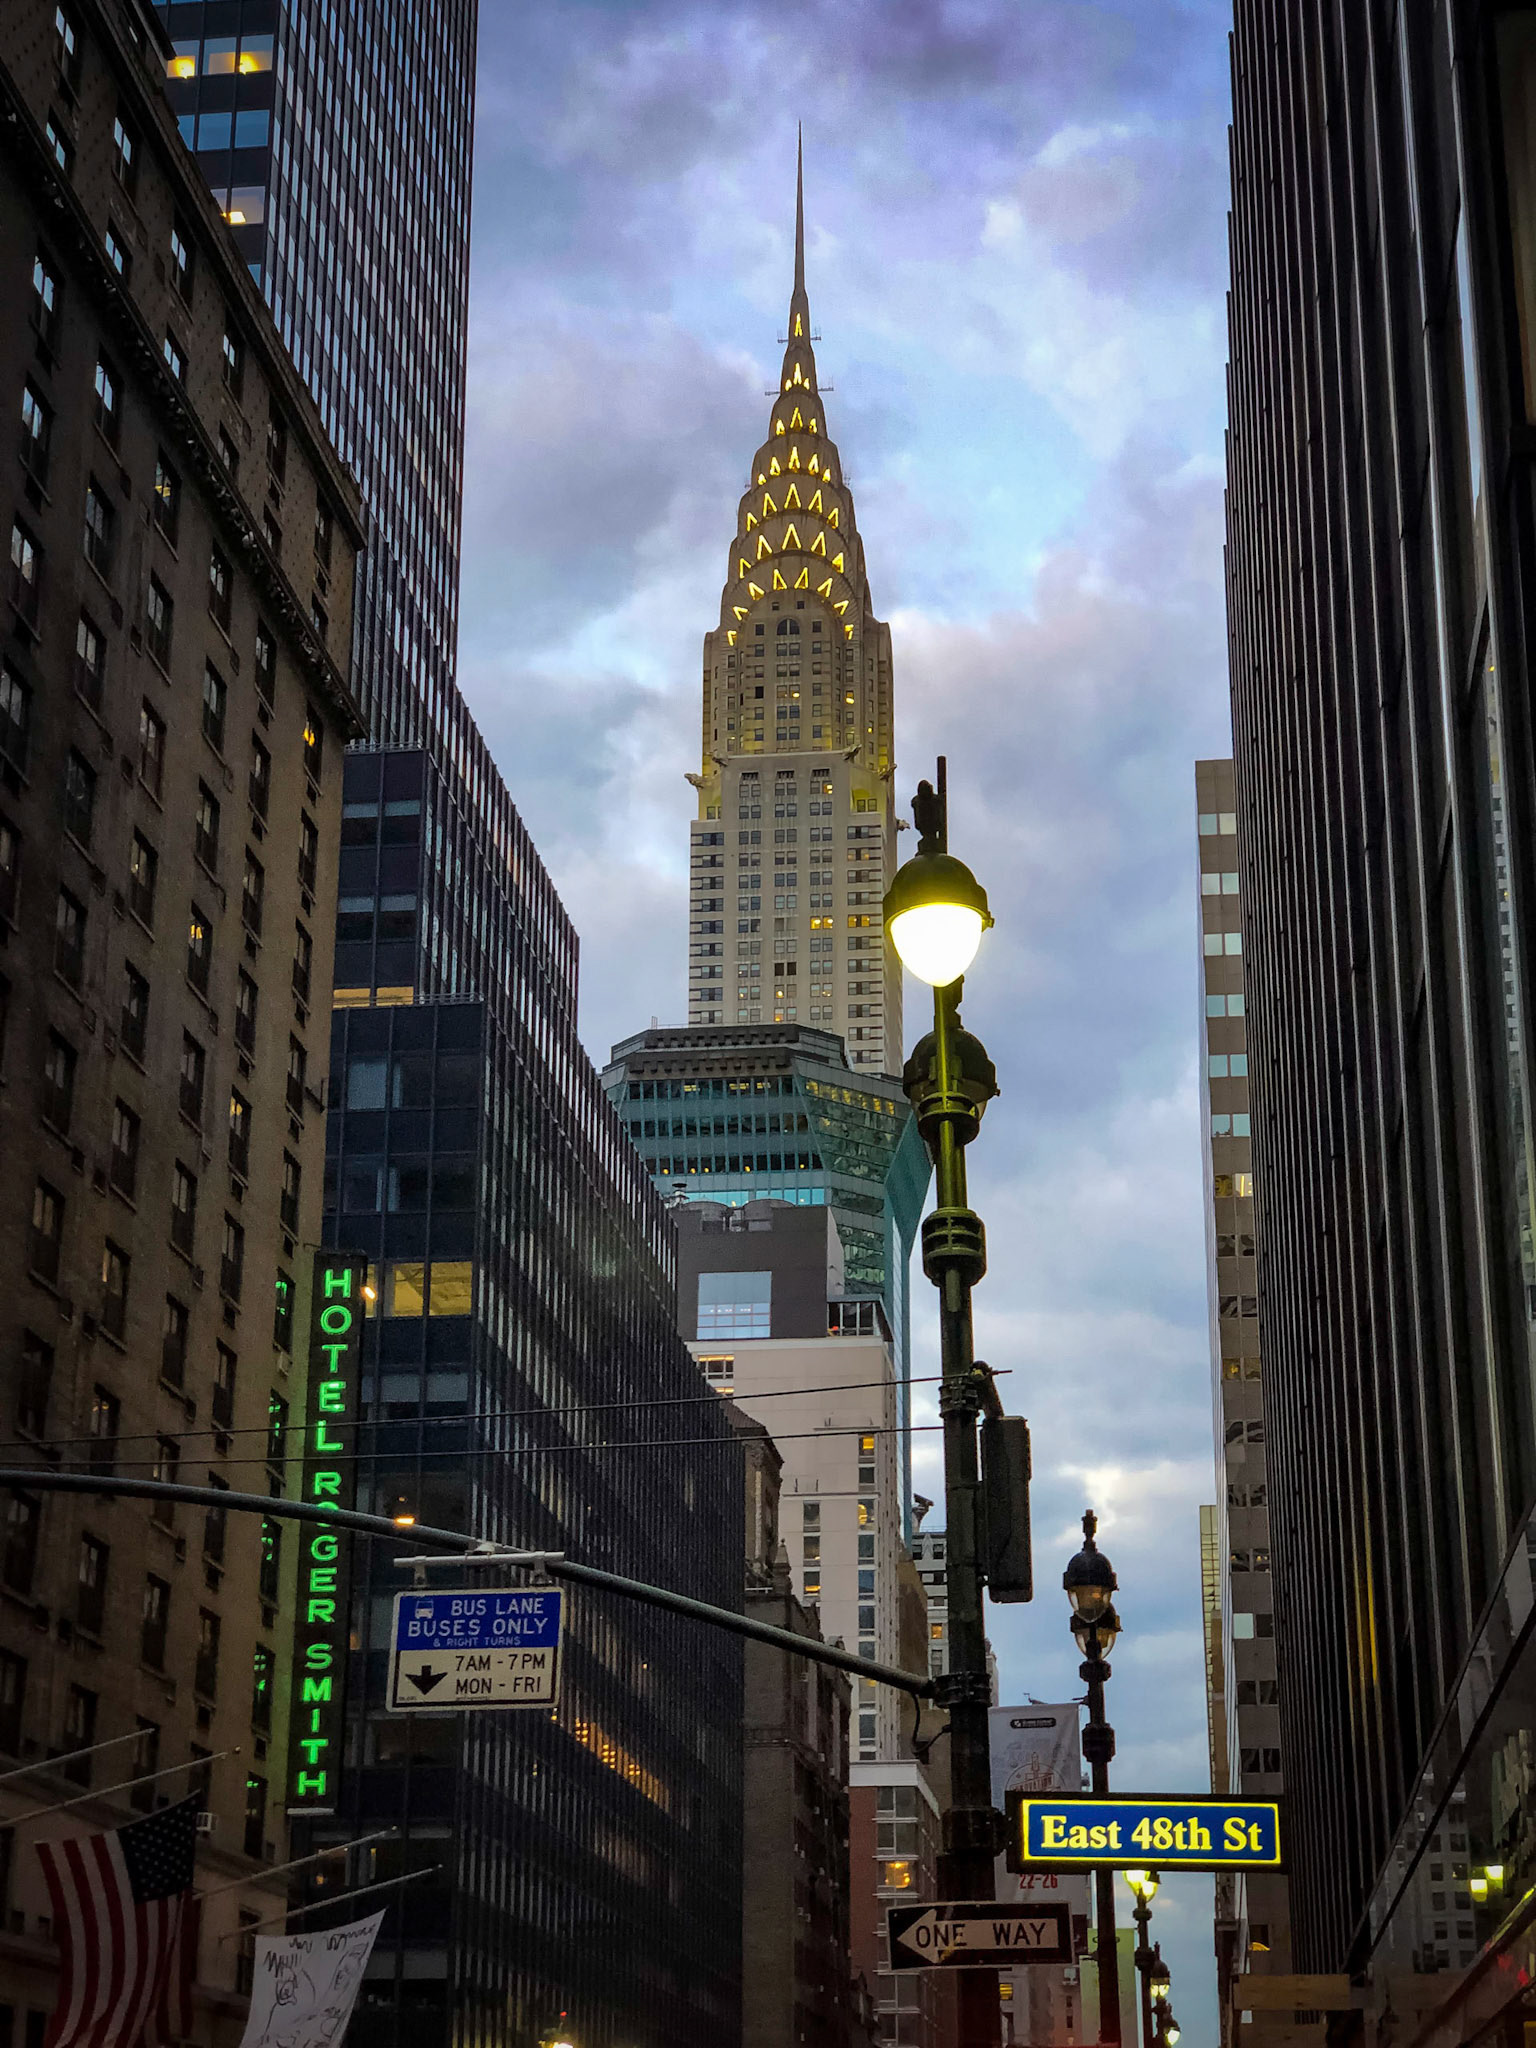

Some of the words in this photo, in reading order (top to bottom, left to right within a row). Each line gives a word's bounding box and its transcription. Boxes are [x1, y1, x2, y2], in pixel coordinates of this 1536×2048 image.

[315, 1268, 353, 1452] HOTEL
[451, 1600, 486, 1616] BUS
[496, 1598, 544, 1615] LANE
[408, 1618, 480, 1637] BUSES
[493, 1617, 548, 1635] ONLY
[433, 1638, 441, 1647] &
[446, 1637, 479, 1647] RIGHT
[484, 1636, 521, 1646] TURNS
[455, 1655, 491, 1672] 7AM
[455, 1677, 493, 1695] MON
[513, 1676, 541, 1693] FRI
[297, 1643, 333, 1796] SMITH
[1041, 1815, 1122, 1850] East
[1131, 1816, 1213, 1851] 48th
[1223, 1817, 1263, 1851] St
[915, 1923, 968, 1949] ONE
[993, 1921, 1047, 1947] WAY
